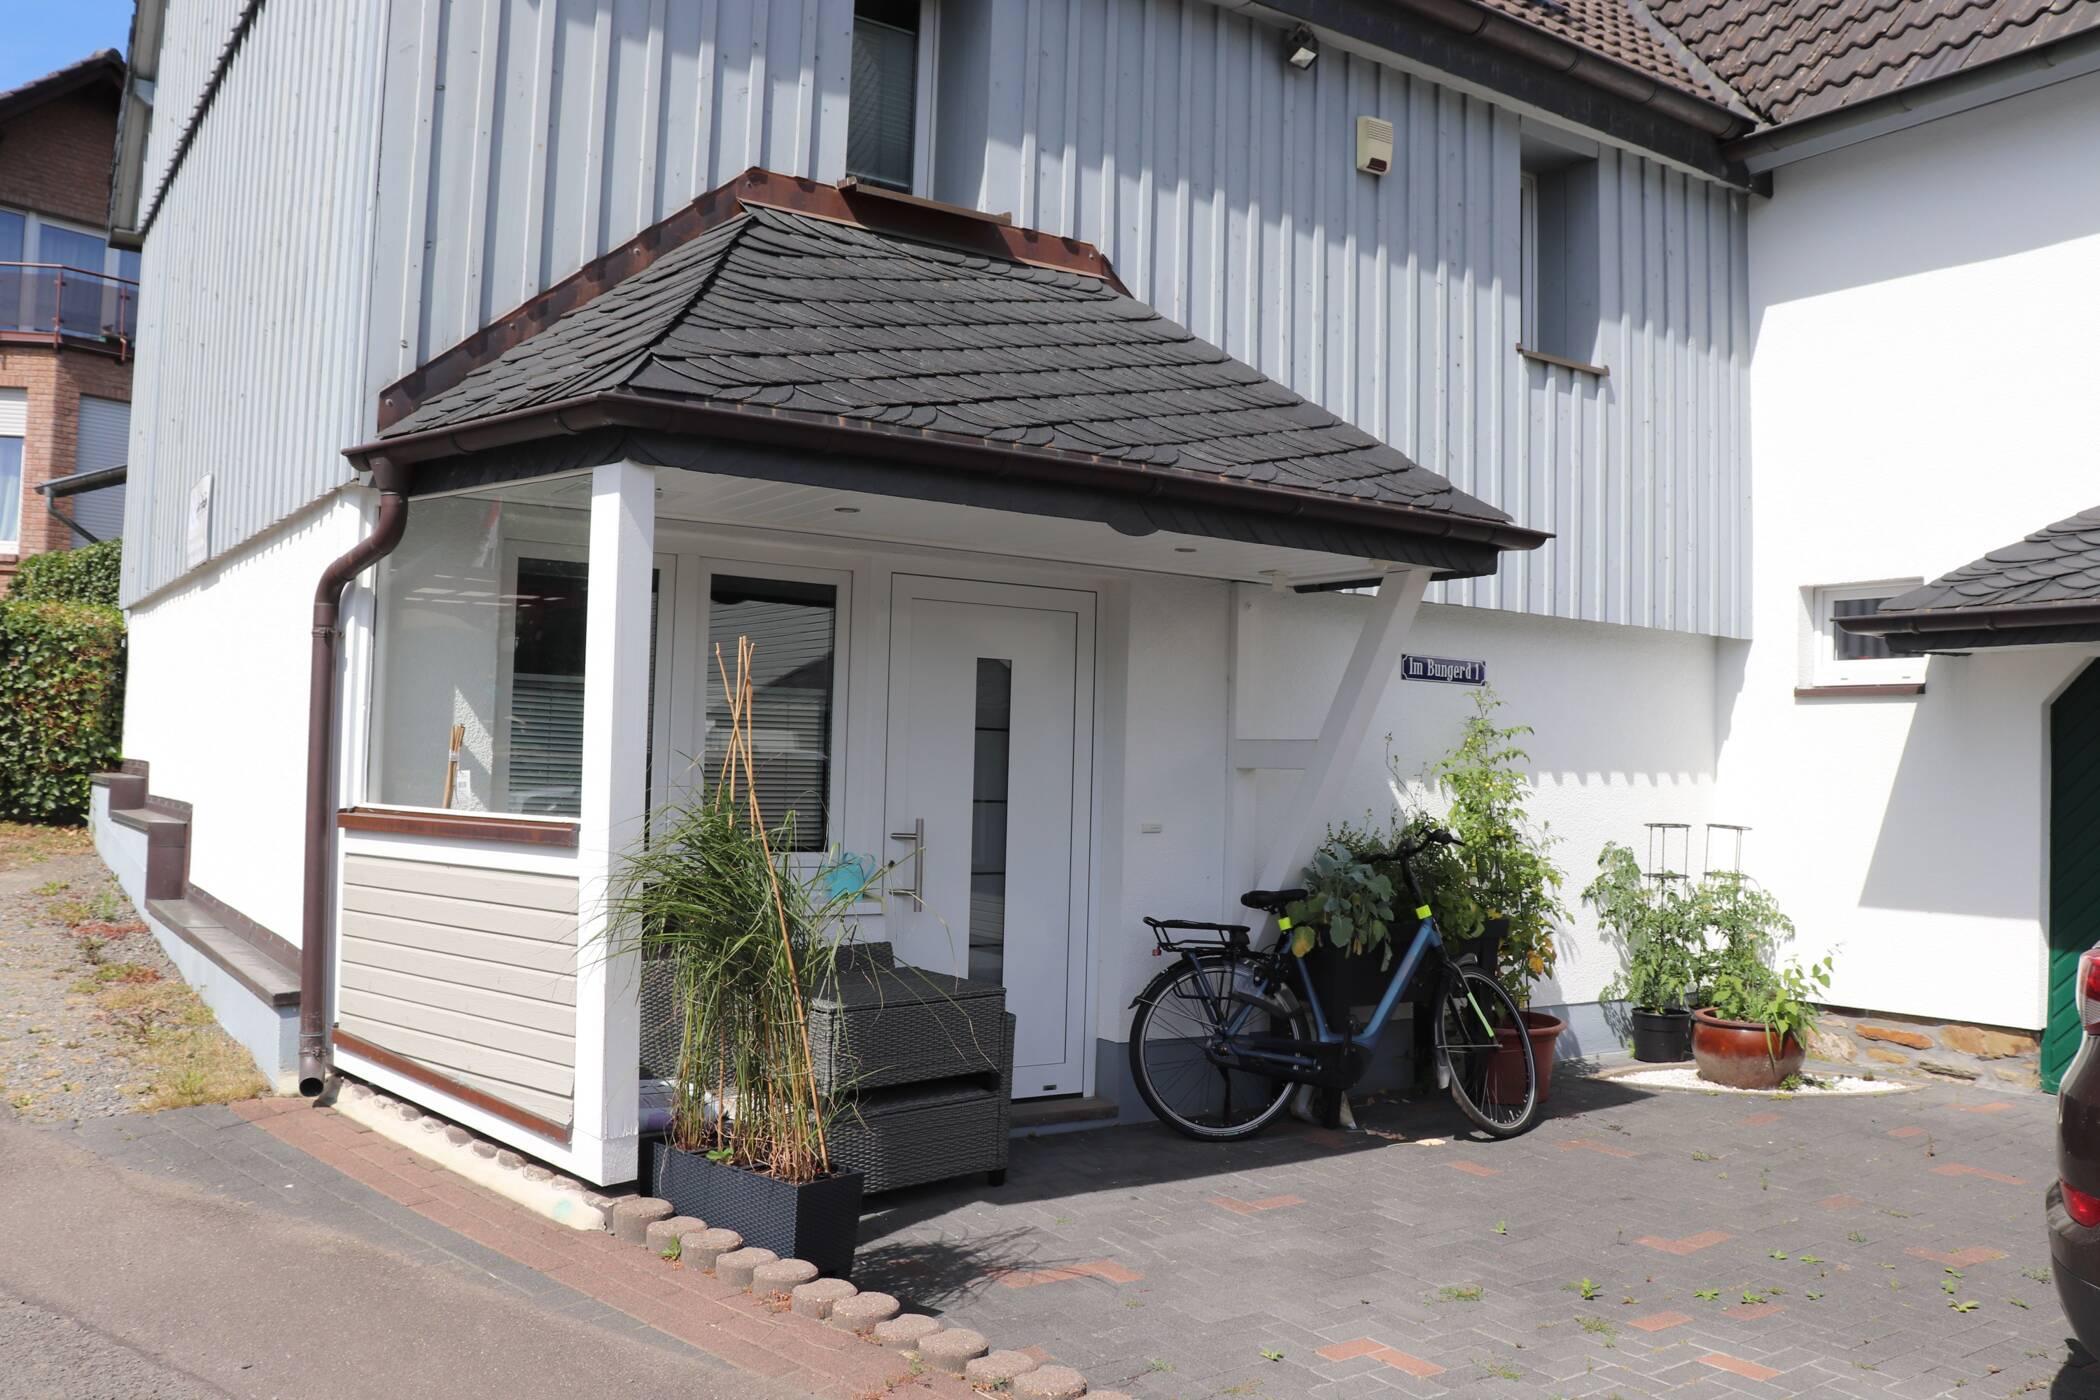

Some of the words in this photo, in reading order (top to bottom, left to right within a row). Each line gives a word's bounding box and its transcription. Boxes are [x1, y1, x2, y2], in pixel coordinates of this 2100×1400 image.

[1409, 657, 1423, 675] Im
[1427, 658, 1471, 681] Bungerd
[1475, 663, 1479, 680] 1
